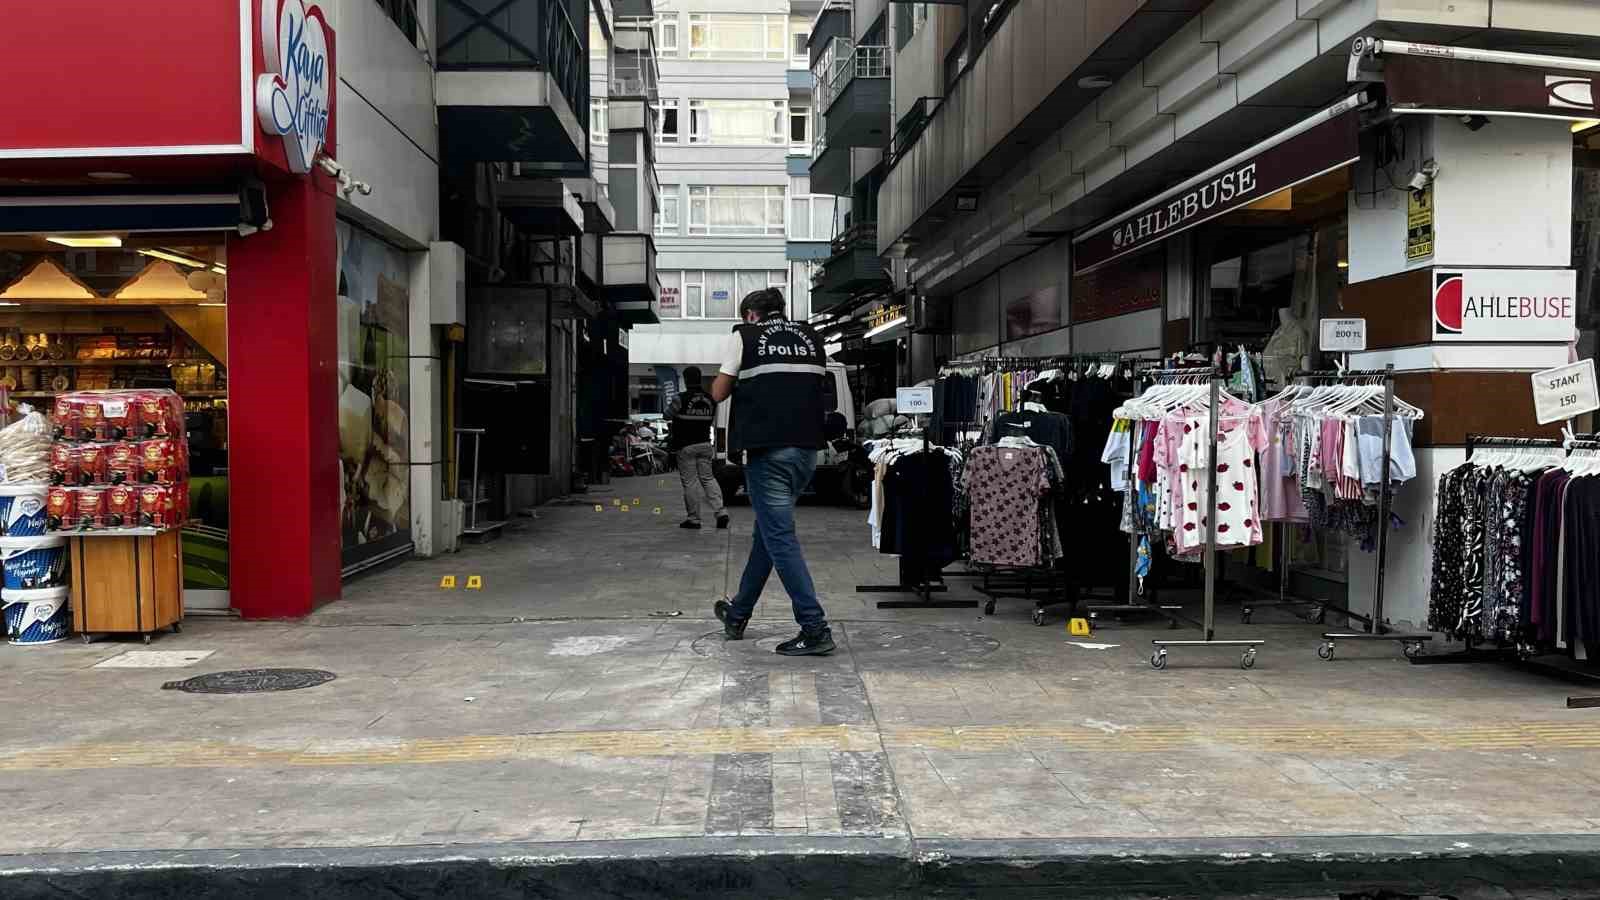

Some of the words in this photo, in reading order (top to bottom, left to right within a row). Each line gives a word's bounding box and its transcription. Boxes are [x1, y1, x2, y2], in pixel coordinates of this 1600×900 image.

[279, 13, 324, 108] Kaya
[1122, 163, 1256, 247] AHLEBUSE
[1463, 296, 1573, 319] AHLEBUSE
[1335, 330, 1351, 338] 200
[1548, 372, 1582, 391] STANT
[1559, 394, 1578, 408] 150
